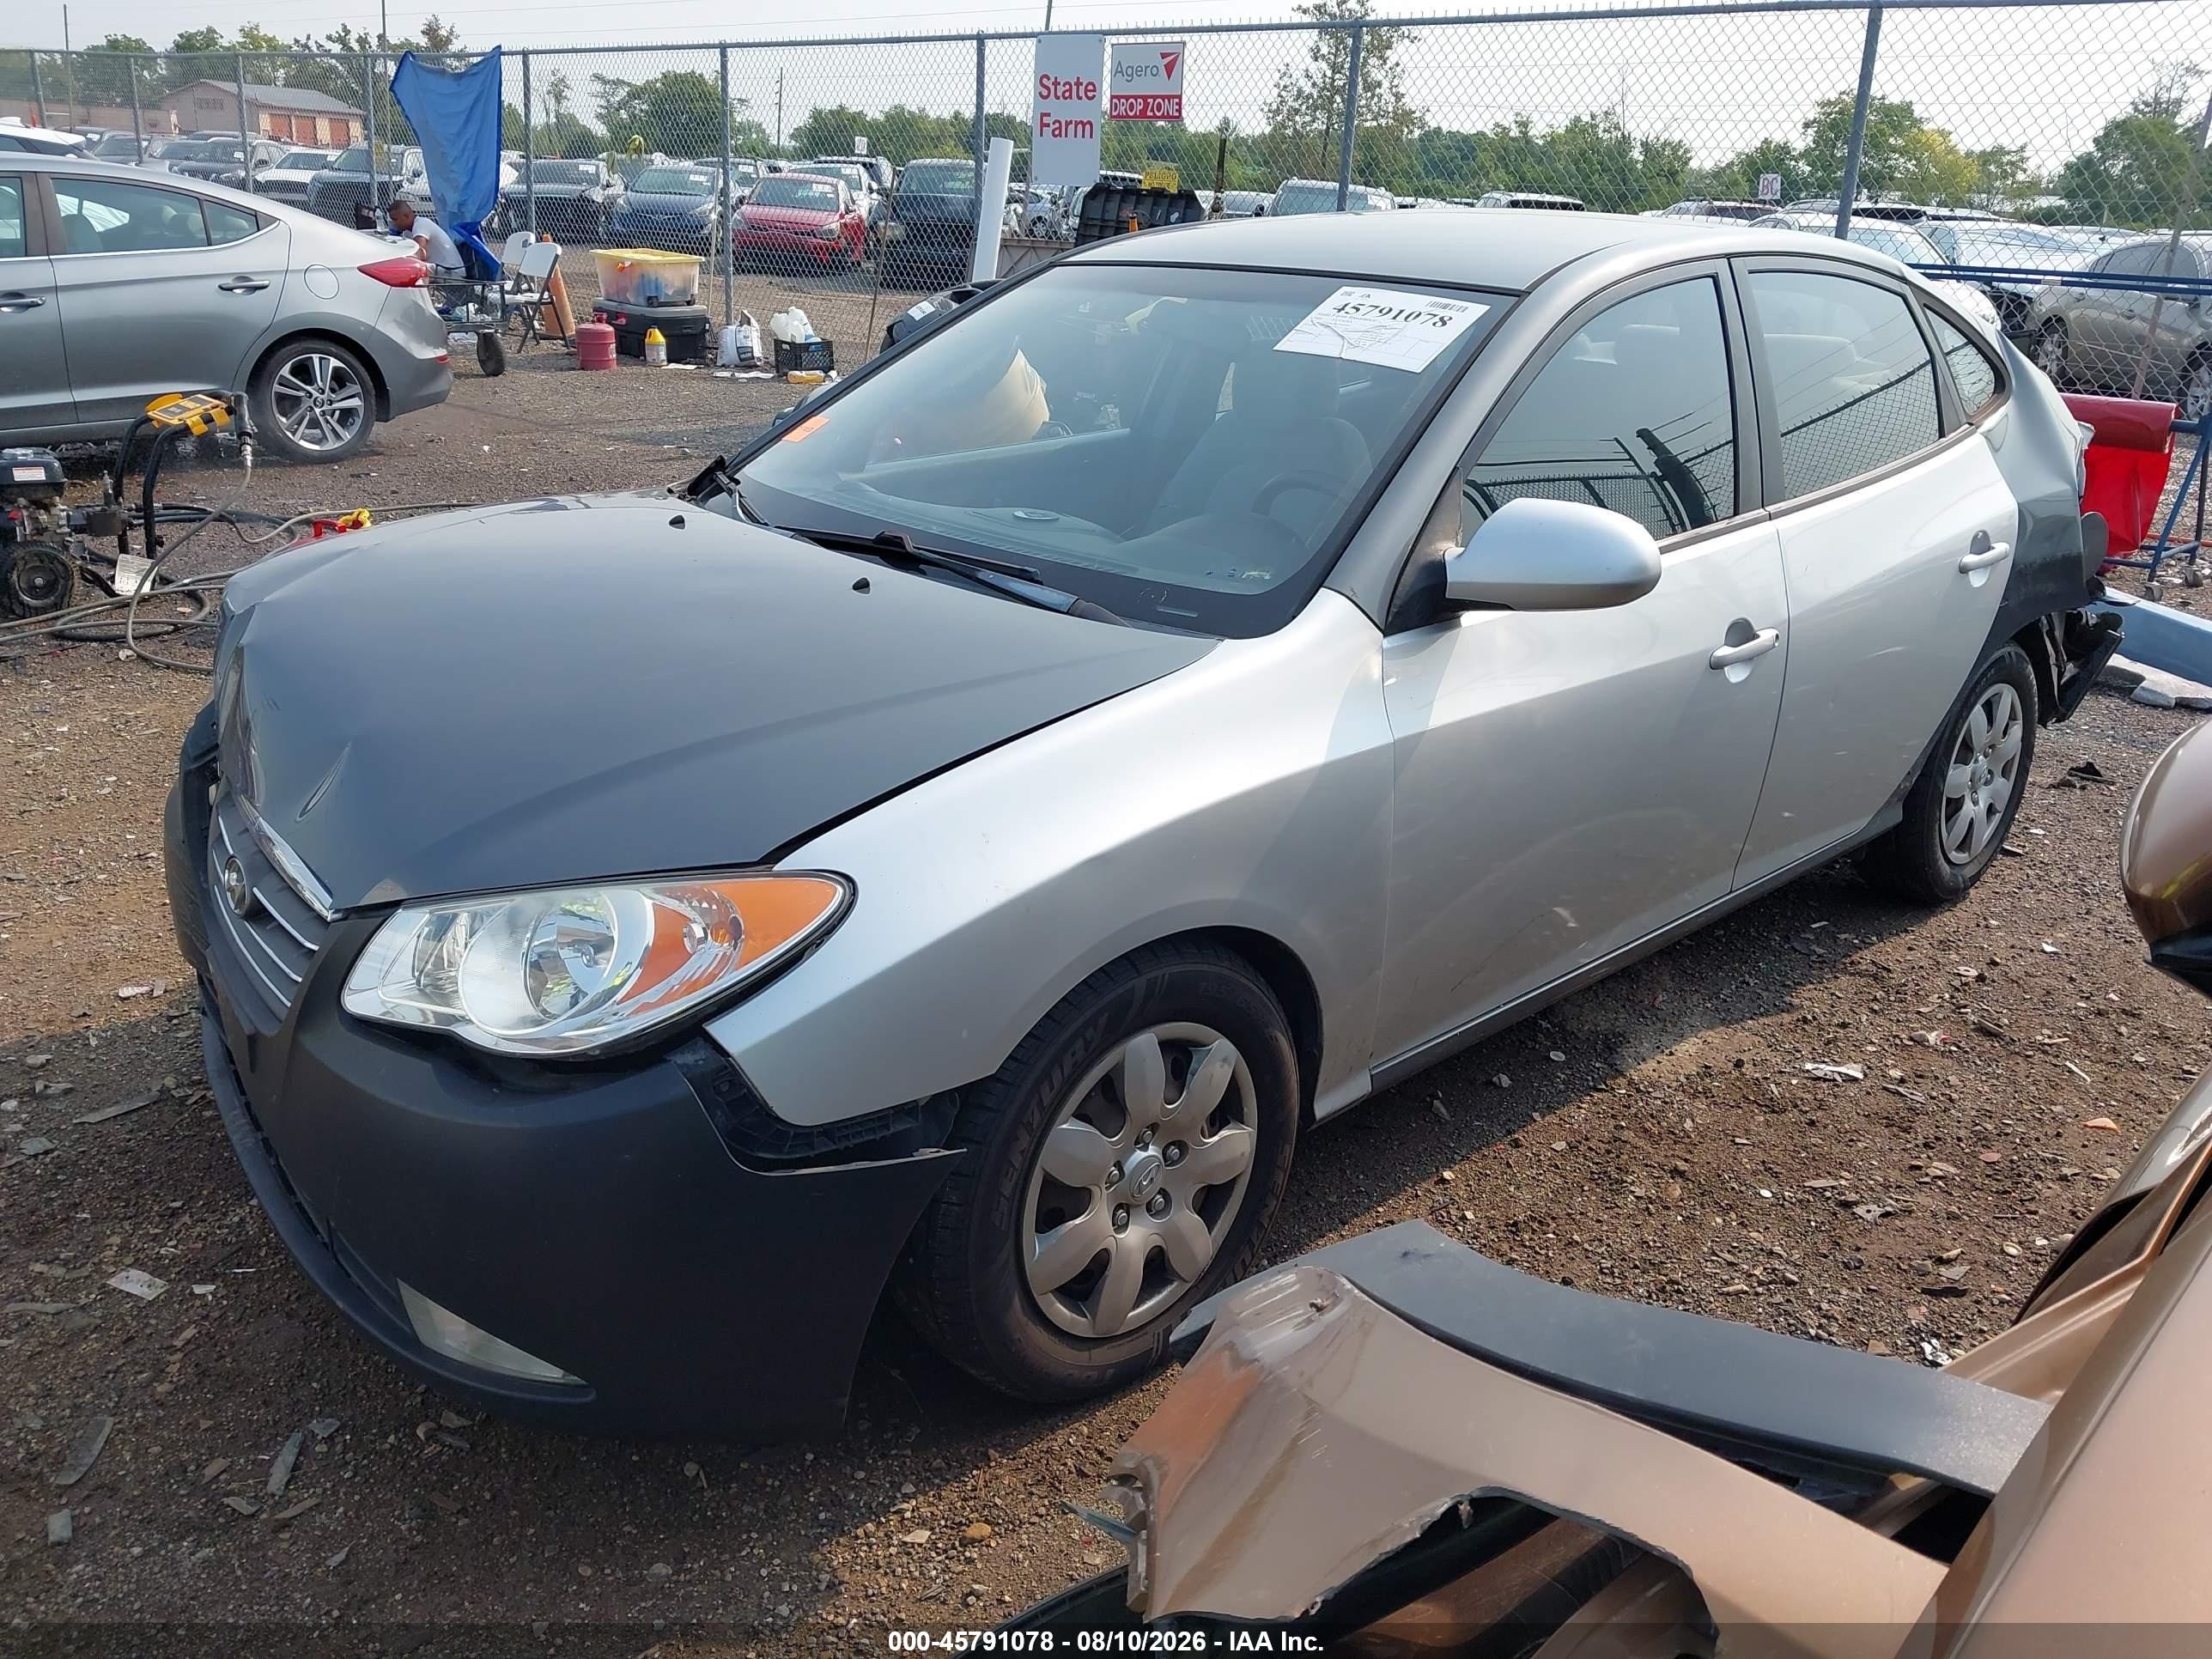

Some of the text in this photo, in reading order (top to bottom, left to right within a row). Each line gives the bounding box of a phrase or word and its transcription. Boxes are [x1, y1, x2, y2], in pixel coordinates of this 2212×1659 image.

[1114, 60, 1159, 82] Agero
[1038, 74, 1097, 100] State
[1112, 97, 1180, 117] DROP ZONE
[1039, 112, 1094, 139] Farm
[1762, 177, 1778, 196] BC
[1333, 301, 1454, 328] 45791078
